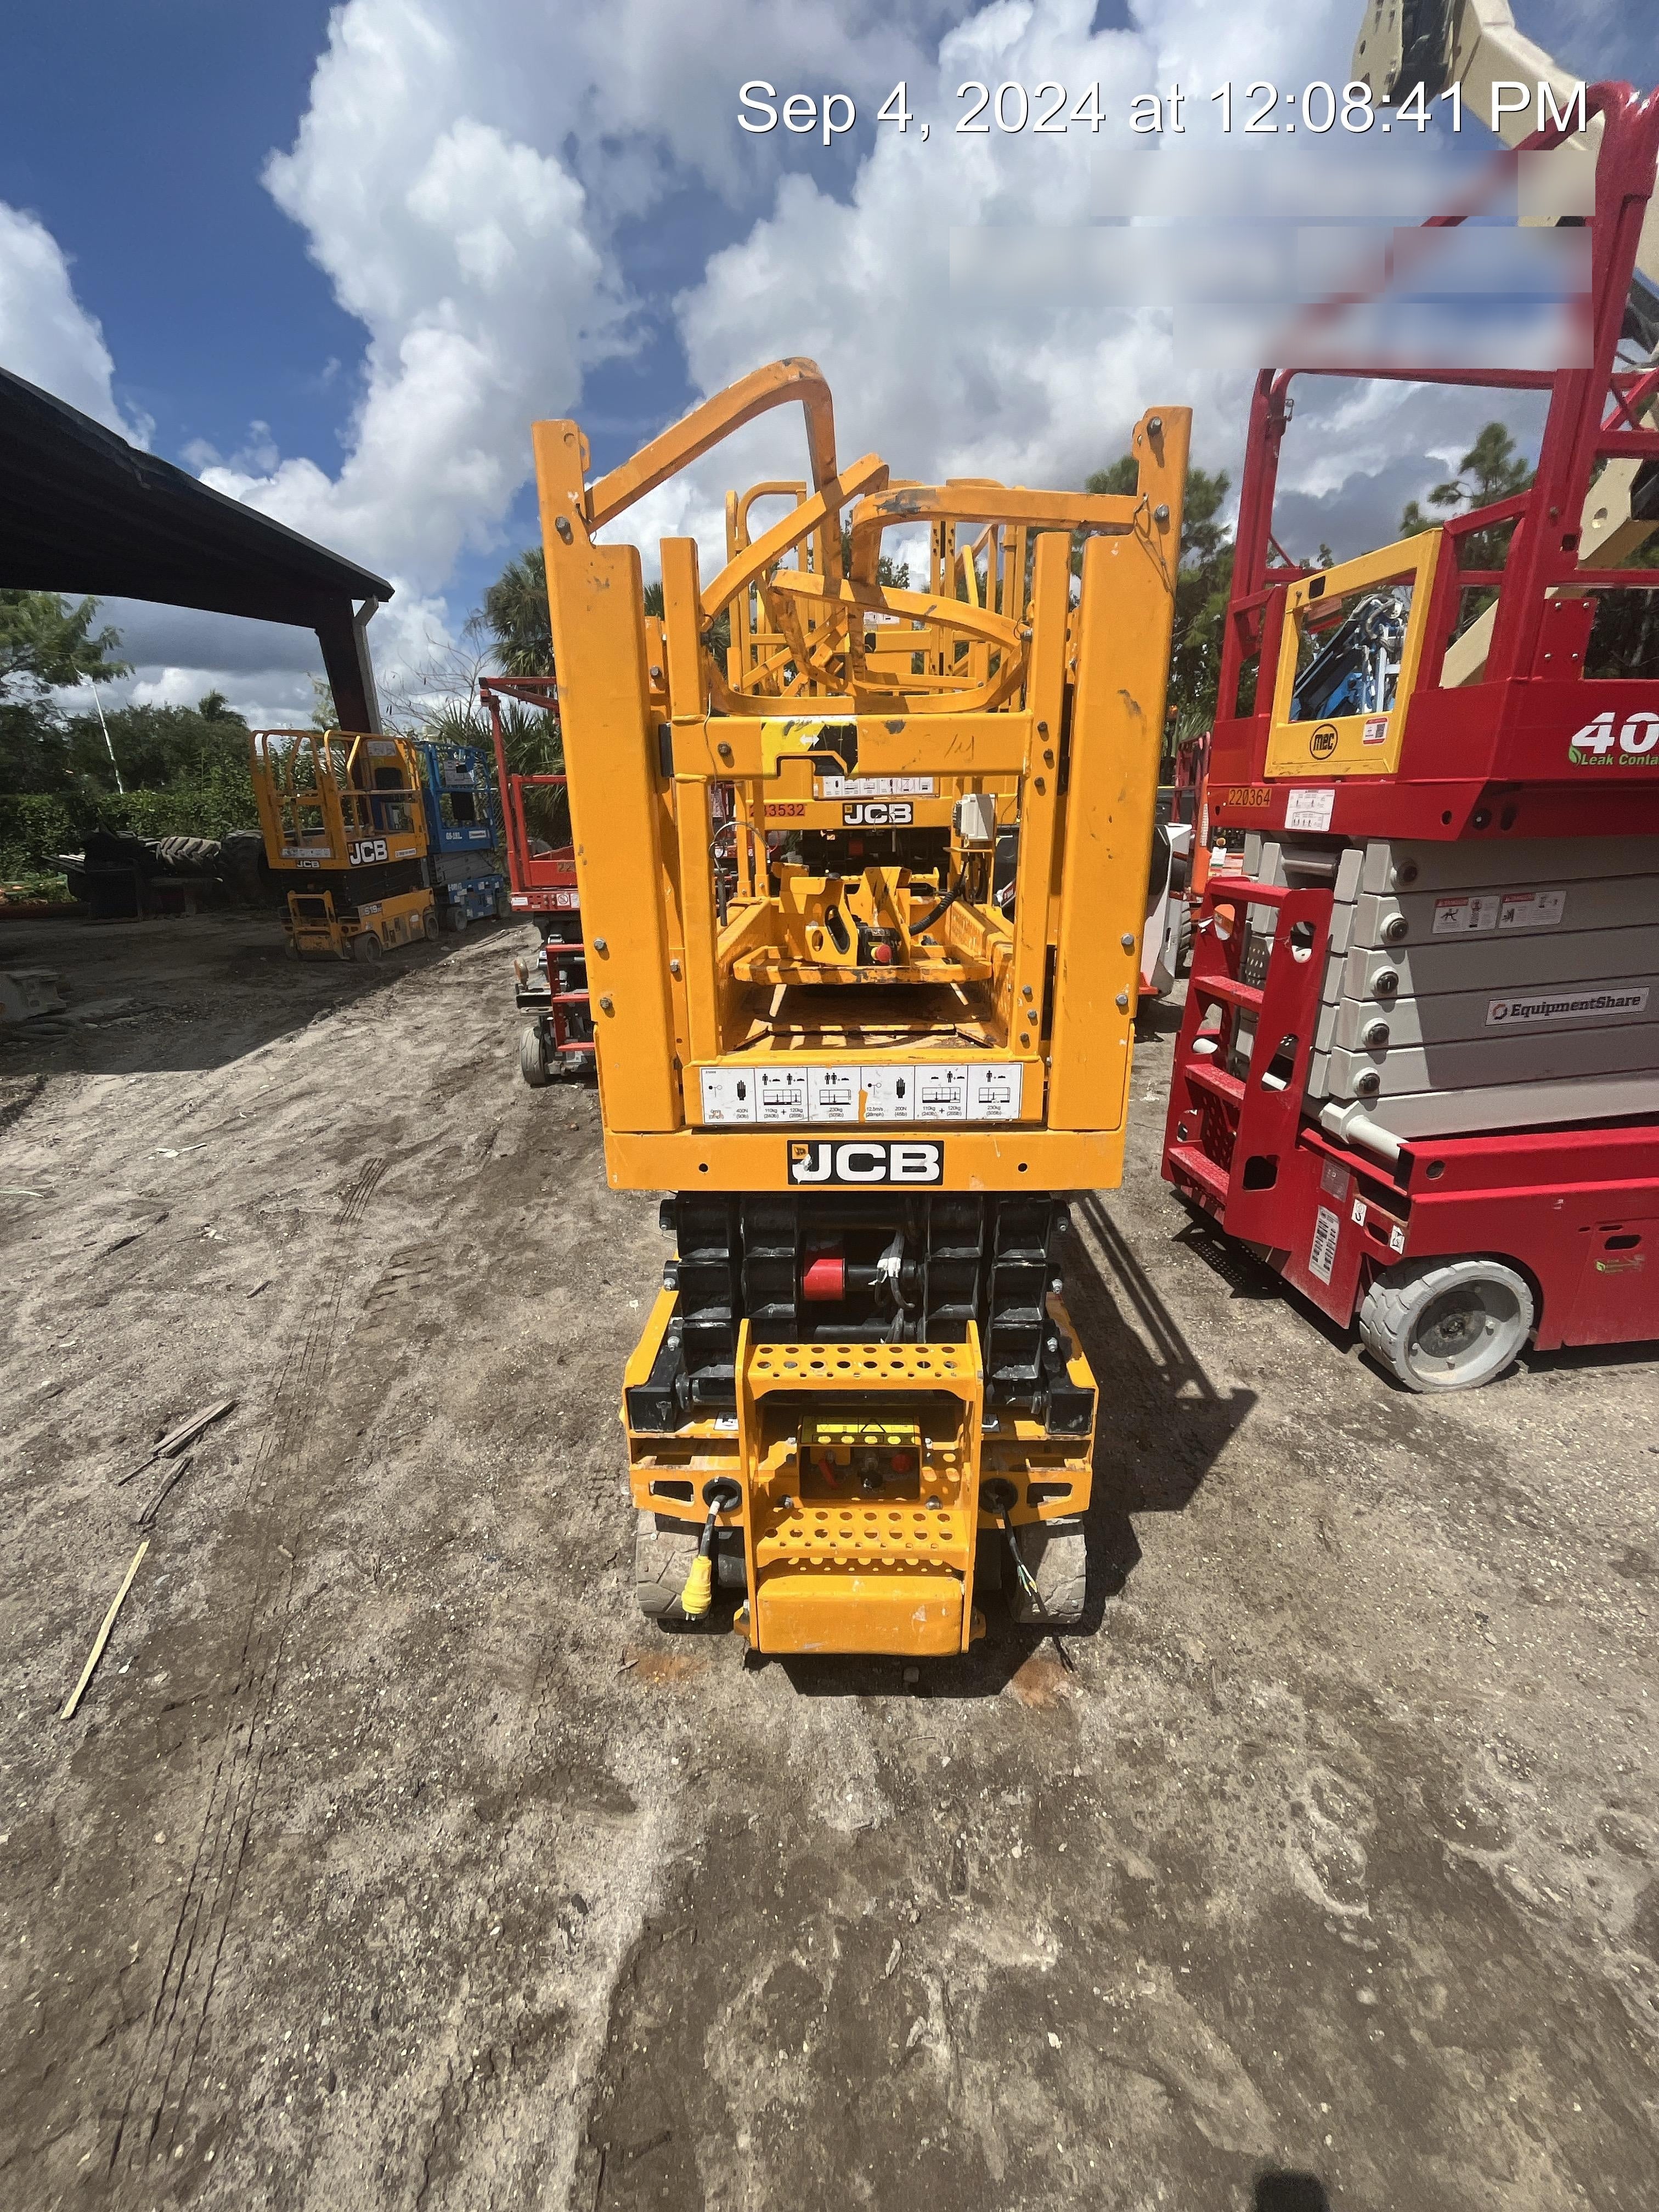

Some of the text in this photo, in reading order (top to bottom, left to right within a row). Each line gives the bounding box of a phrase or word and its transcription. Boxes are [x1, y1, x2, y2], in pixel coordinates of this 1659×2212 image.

[1572, 712, 1659, 754] 40
[1581, 754, 1614, 765] Leak
[1229, 788, 1271, 806] 220364
[844, 804, 912, 823] JCB
[349, 840, 388, 865] JCB
[1510, 996, 1641, 1018] EquipmentShare
[792, 1143, 940, 1182] JCB
